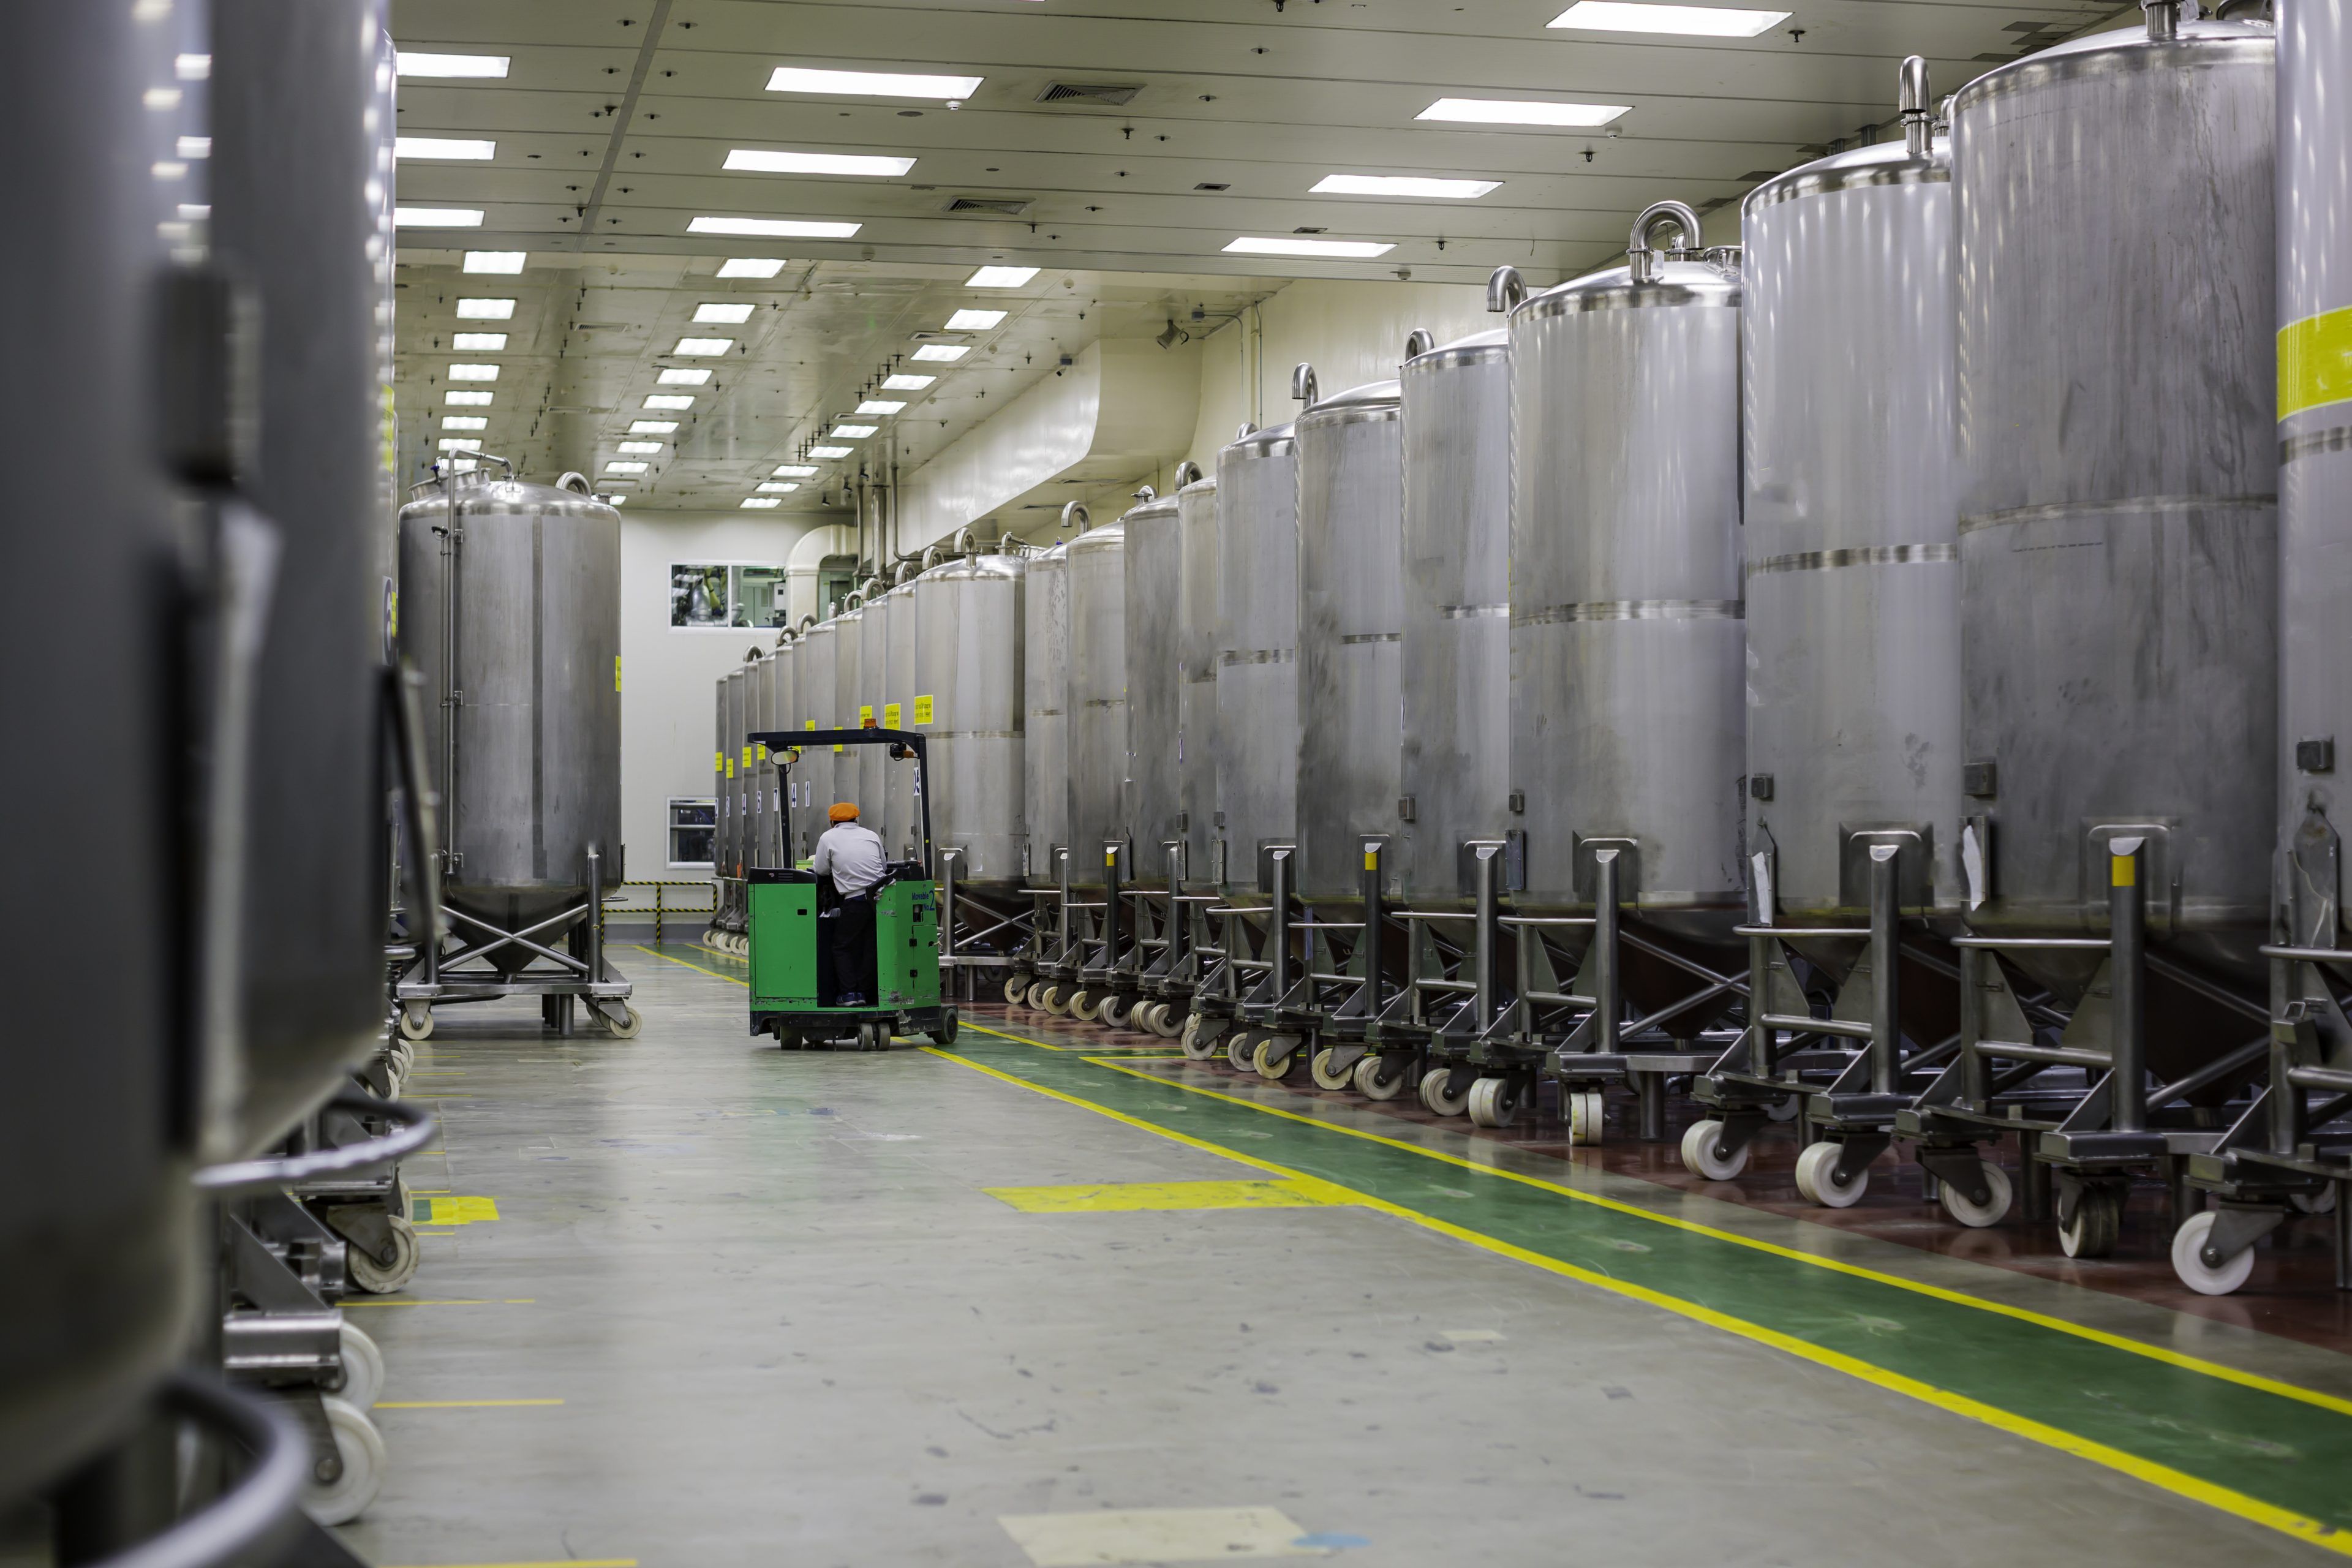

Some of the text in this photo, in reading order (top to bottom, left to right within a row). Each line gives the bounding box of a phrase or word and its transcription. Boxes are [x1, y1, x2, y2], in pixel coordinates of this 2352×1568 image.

[383, 578, 392, 665] 6
[774, 789, 778, 810] 7
[792, 783, 796, 806] 4
[911, 891, 929, 900] Movable
[929, 890, 935, 911] 2
